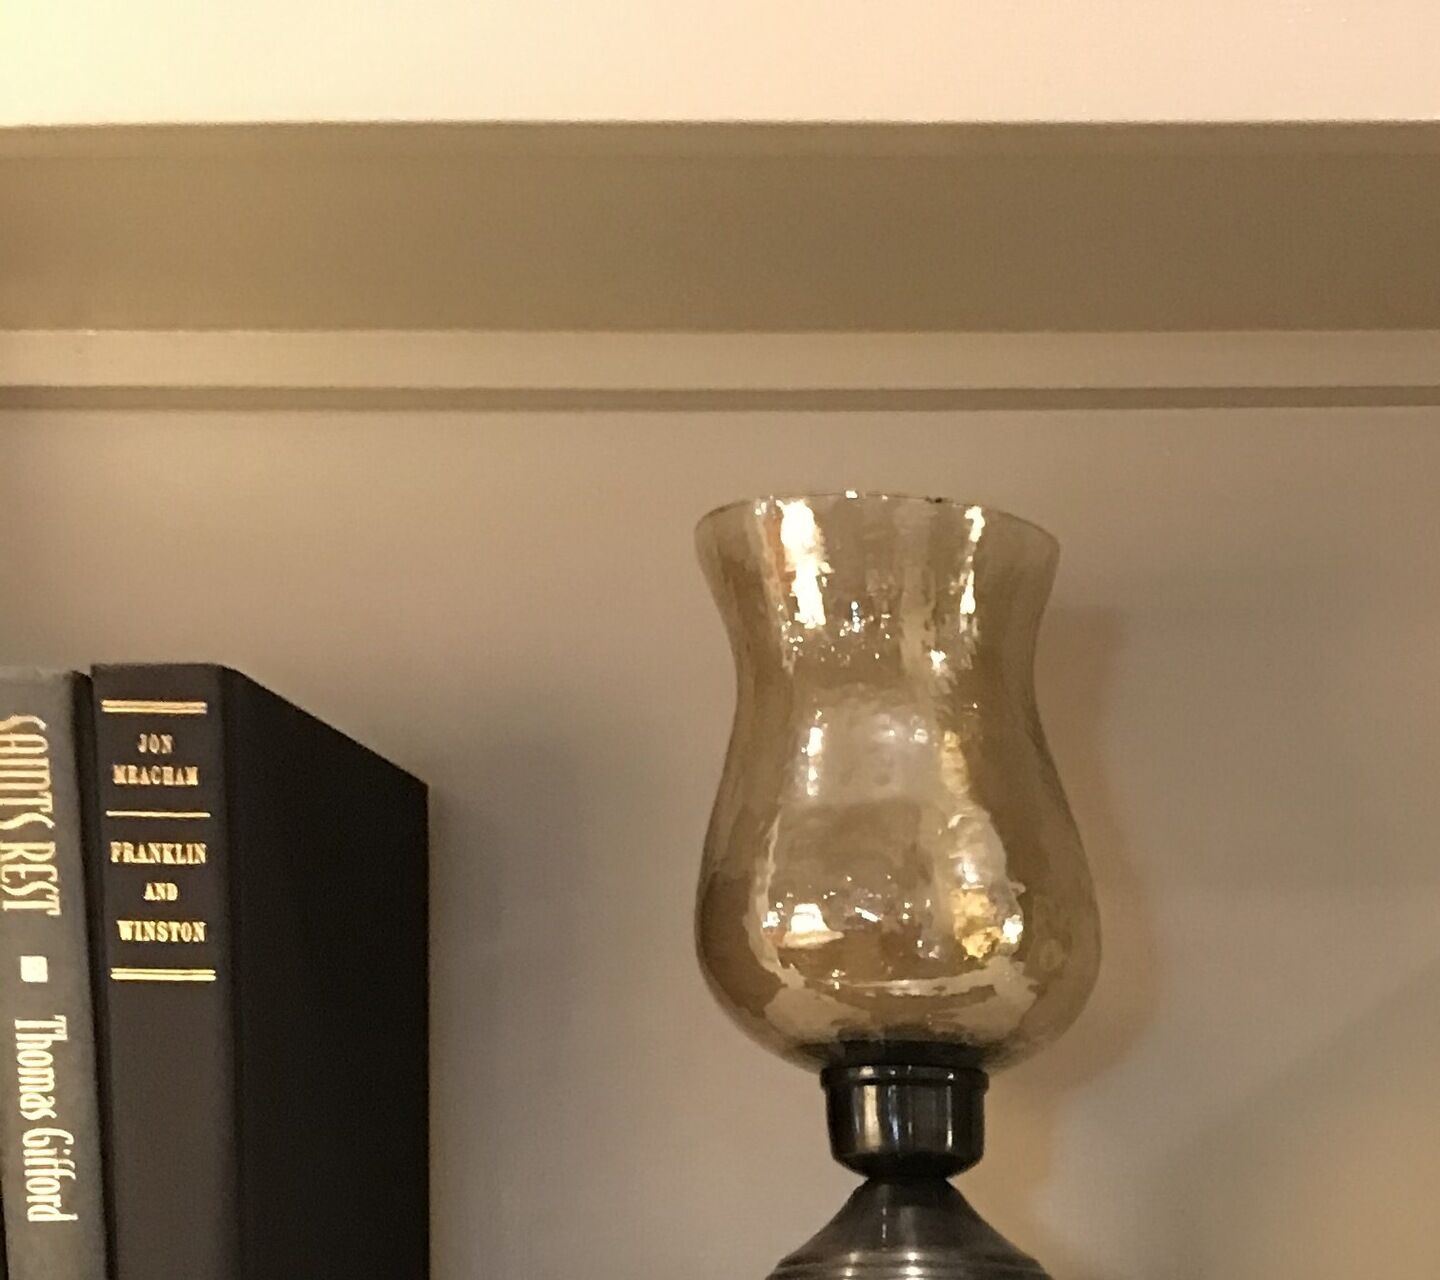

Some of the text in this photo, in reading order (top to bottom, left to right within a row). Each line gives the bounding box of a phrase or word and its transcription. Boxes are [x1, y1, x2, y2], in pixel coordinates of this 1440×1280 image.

[137, 733, 173, 754] JON
[112, 765, 198, 786] MEACHAM
[110, 841, 207, 865] FRANKLIN
[143, 882, 178, 901] AND
[117, 920, 206, 943] WINSTON
[14, 1015, 80, 1223] Thomas Gifford
